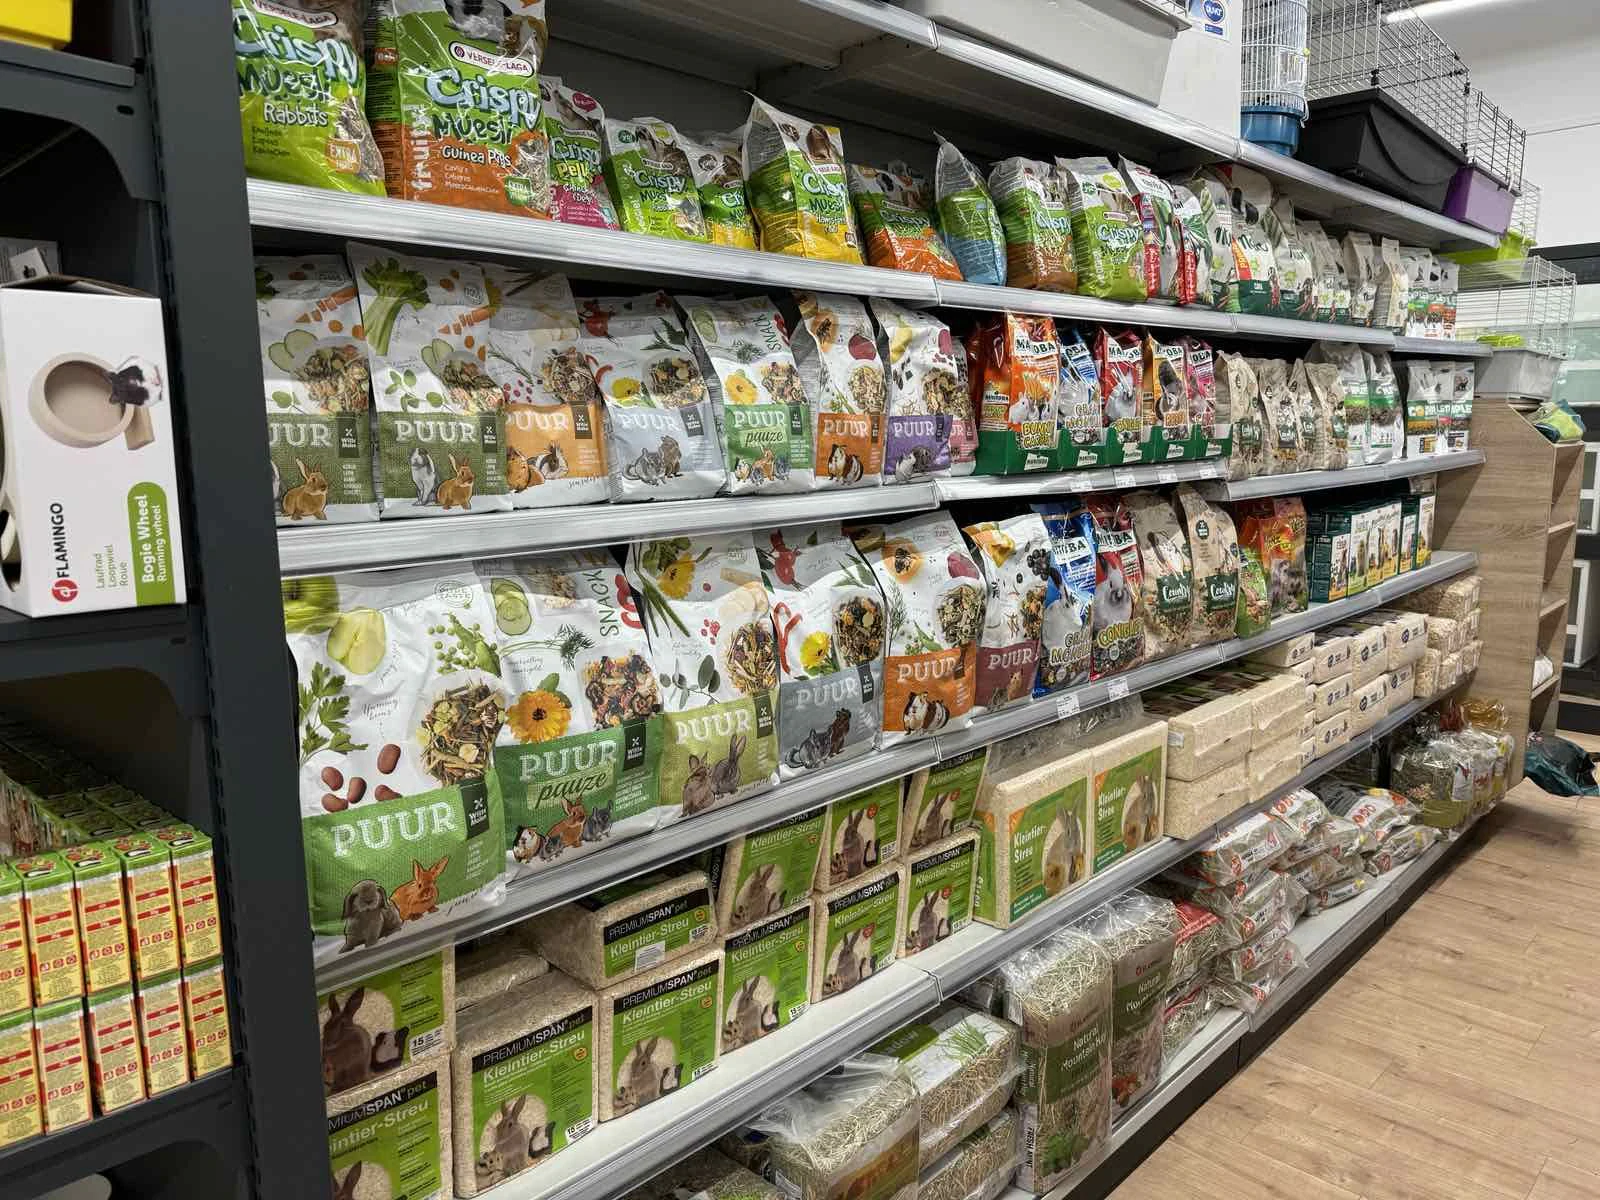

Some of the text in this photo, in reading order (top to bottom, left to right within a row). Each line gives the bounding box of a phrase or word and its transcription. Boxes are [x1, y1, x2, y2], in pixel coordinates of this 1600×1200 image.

[263, 101, 328, 128] Rabbits
[425, 68, 542, 130] Crispy
[443, 145, 486, 164] Guinea
[634, 169, 690, 194] Crispy
[753, 312, 782, 352] SNACK
[394, 420, 477, 443] PUUR
[617, 414, 682, 432] PUUR
[733, 410, 786, 428] PUUR
[823, 419, 868, 437] PUUR
[893, 421, 935, 438] PUUR
[745, 428, 784, 447] pauze
[50, 502, 70, 578] FLAMINGO
[134, 494, 156, 583] Bogie Wheel
[150, 504, 168, 582] Running wheel
[93, 553, 106, 589] Laufrad
[104, 543, 118, 588] Loopwiel
[117, 561, 129, 587] Roue
[584, 570, 619, 638] SNACK
[988, 648, 1032, 671] PUUR
[796, 677, 859, 710] PUUR
[676, 709, 752, 745] PUUR
[520, 739, 617, 783] PUUR
[535, 773, 607, 810] pauze
[331, 801, 457, 859] PUUR
[751, 820, 821, 850] Kleintier-Streu
[1014, 846, 1033, 864] Streu
[610, 917, 690, 958] Kleintier-Streu
[732, 927, 805, 963] Kleintier-Streu
[623, 981, 713, 1024] Kleintier-Streu
[482, 1031, 586, 1084] Kleintier-Streu
[328, 1087, 404, 1132] MIUMSPAN
[330, 1100, 430, 1156] intier-Streu
